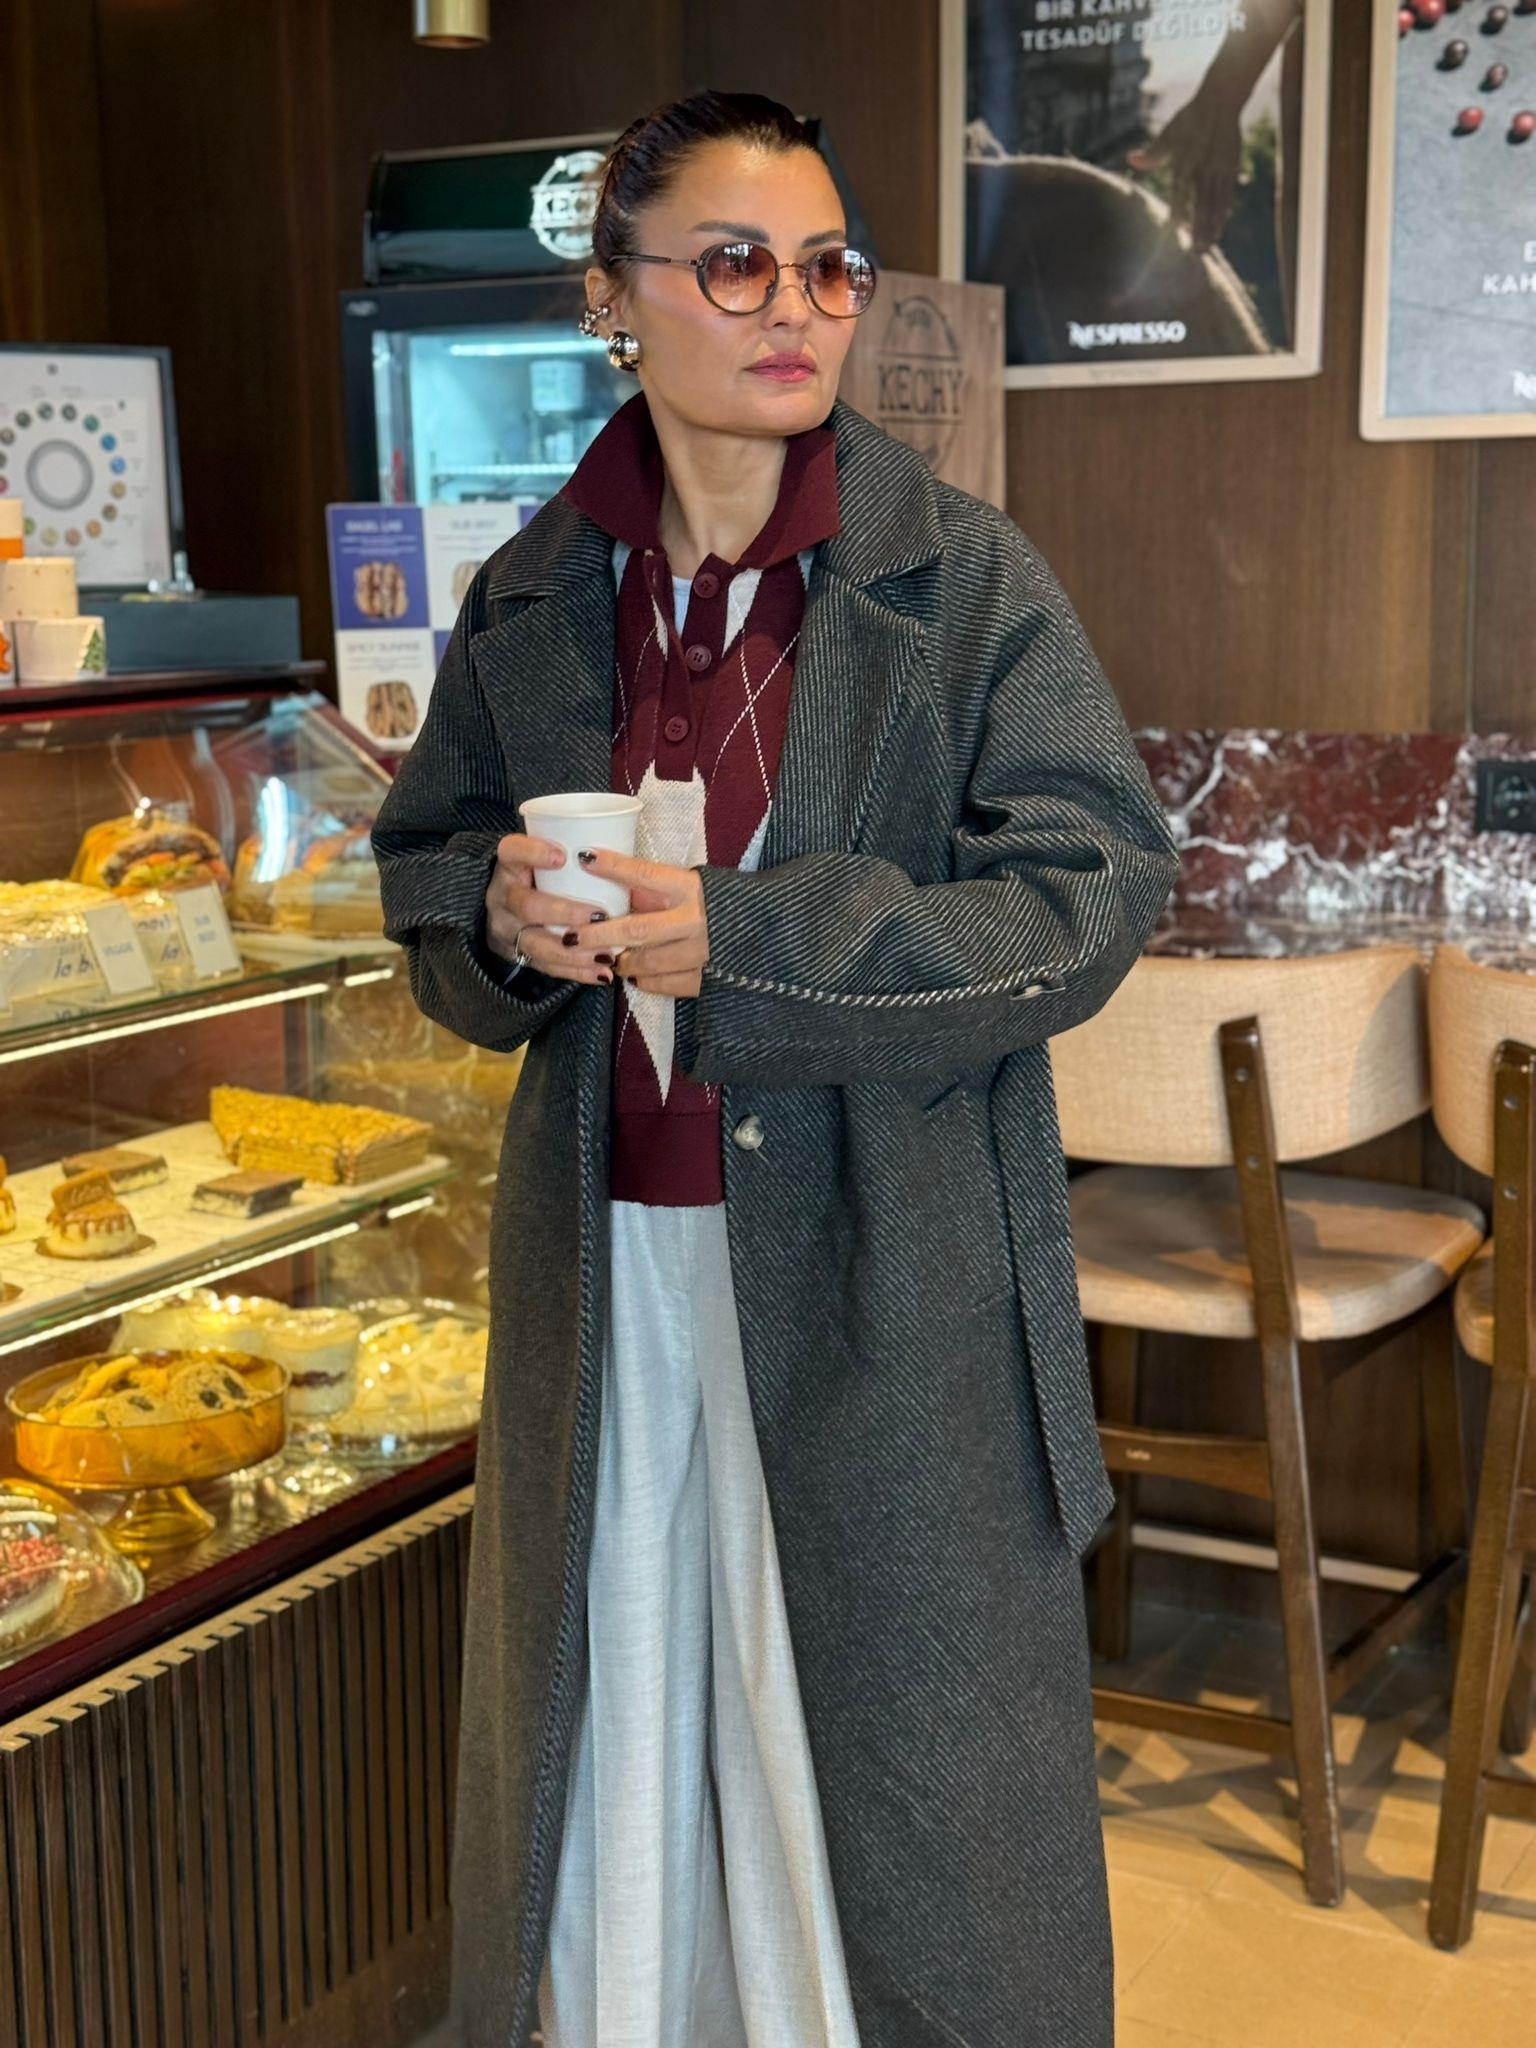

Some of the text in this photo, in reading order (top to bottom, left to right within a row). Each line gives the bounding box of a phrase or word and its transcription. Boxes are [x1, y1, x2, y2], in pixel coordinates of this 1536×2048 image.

[1020, 19, 1126, 50] TESADÜF
[1067, 320, 1187, 350] NESPRESSO
[877, 364, 963, 415] KECHY
